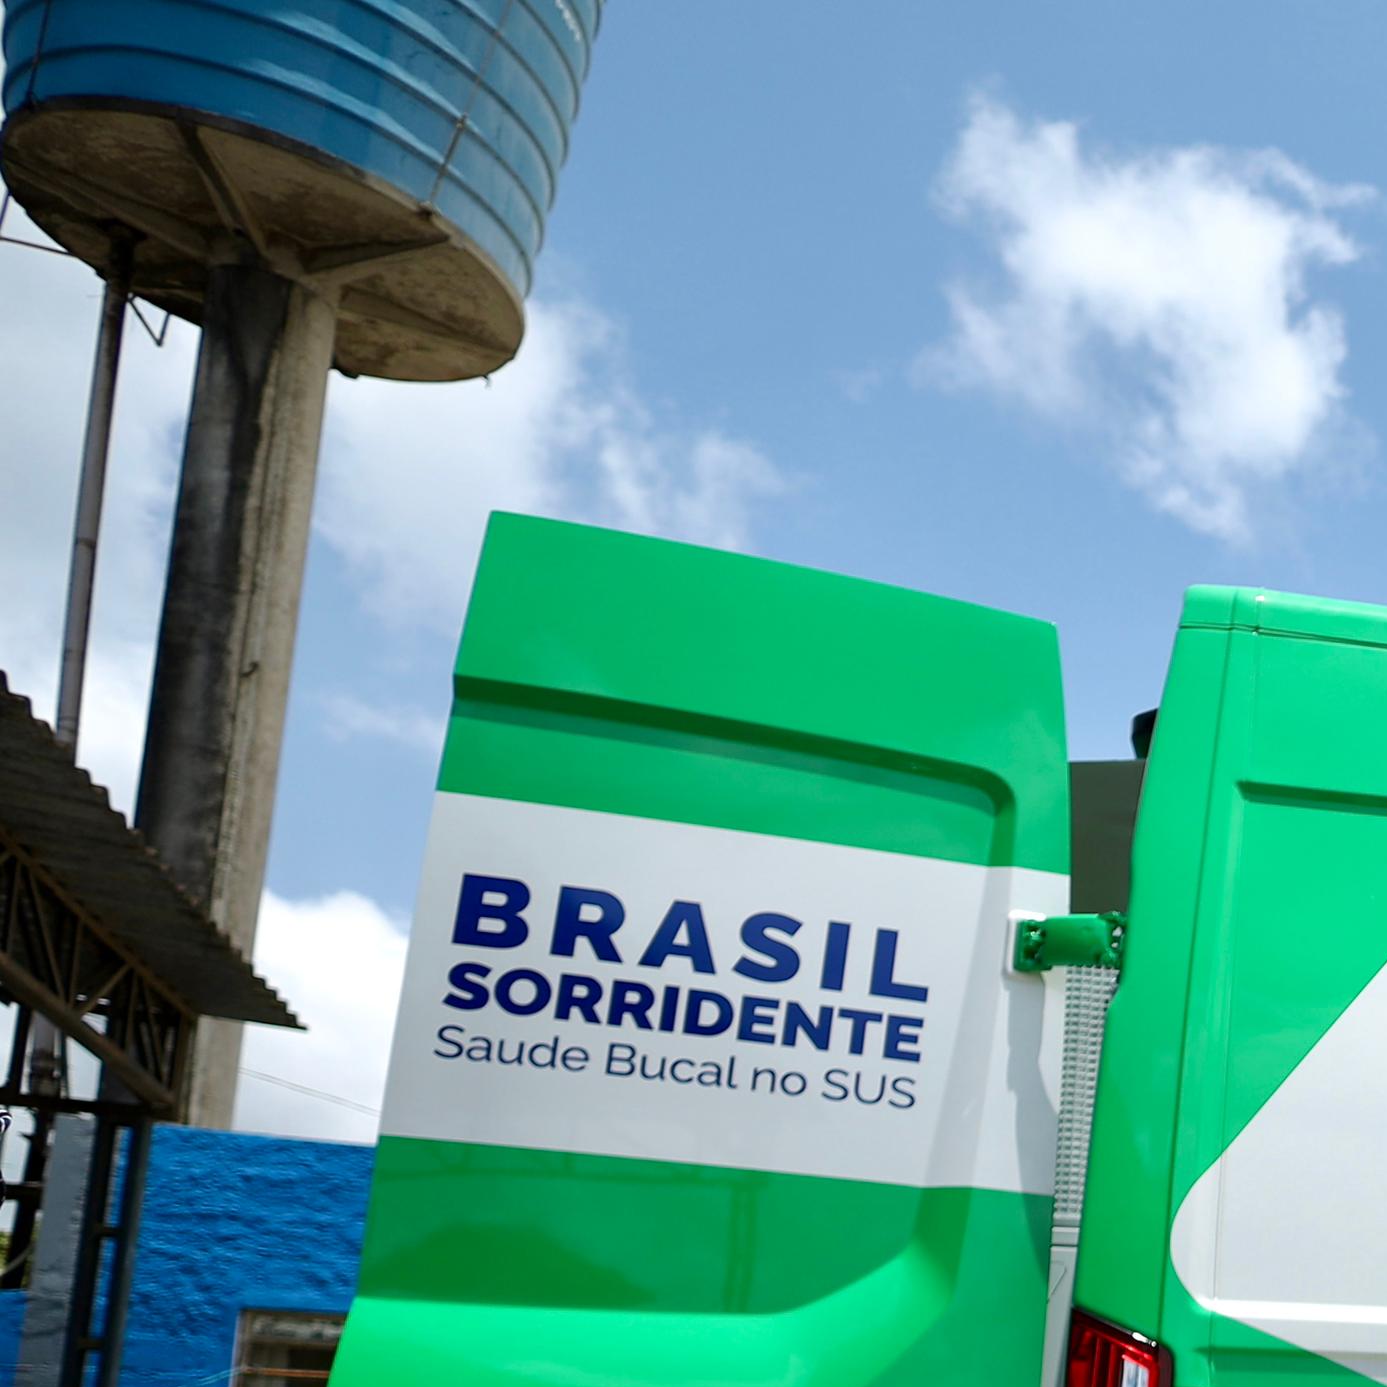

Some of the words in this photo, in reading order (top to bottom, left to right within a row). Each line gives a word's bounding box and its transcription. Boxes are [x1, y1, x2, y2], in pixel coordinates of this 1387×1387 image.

[452, 873, 929, 1003] BRASIL
[443, 962, 925, 1062] SORRIDENTE
[433, 1025, 590, 1071] Saude
[605, 1042, 737, 1089] Bucal
[751, 1067, 807, 1096] no
[821, 1068, 916, 1109] SUS
